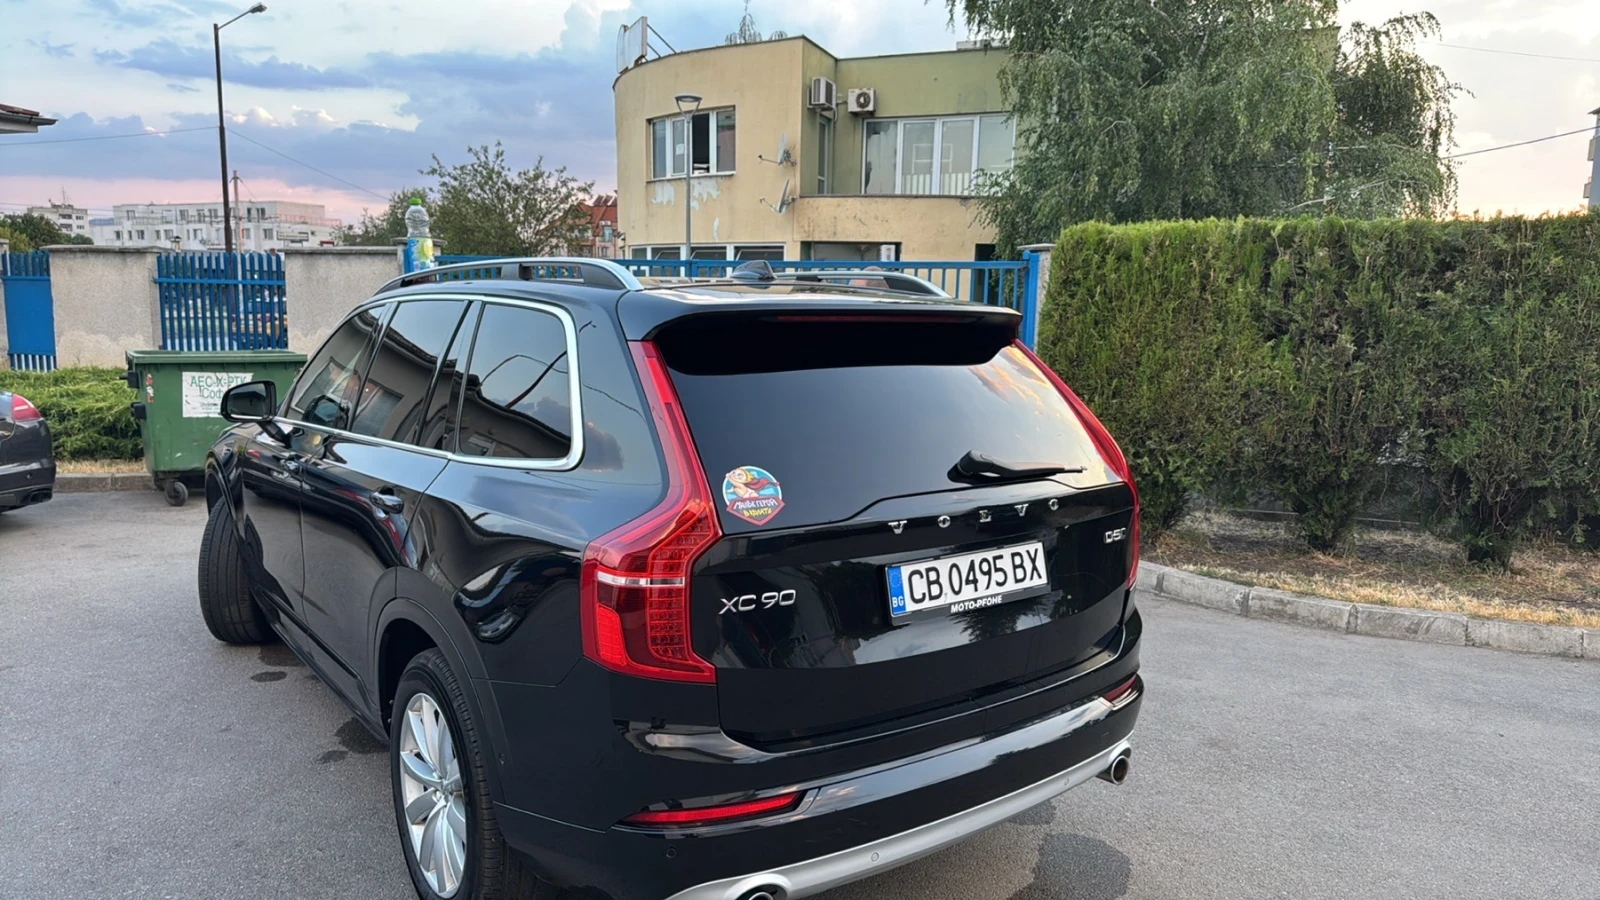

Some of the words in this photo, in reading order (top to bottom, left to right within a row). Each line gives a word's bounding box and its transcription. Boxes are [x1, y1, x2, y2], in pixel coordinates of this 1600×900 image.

[888, 498, 1059, 534] VOLVO
[908, 566, 943, 604] CB
[948, 554, 1008, 596] 0495
[1011, 548, 1042, 584] BX
[892, 596, 904, 608] BG
[950, 595, 1003, 613] MOTO-PFOHE
